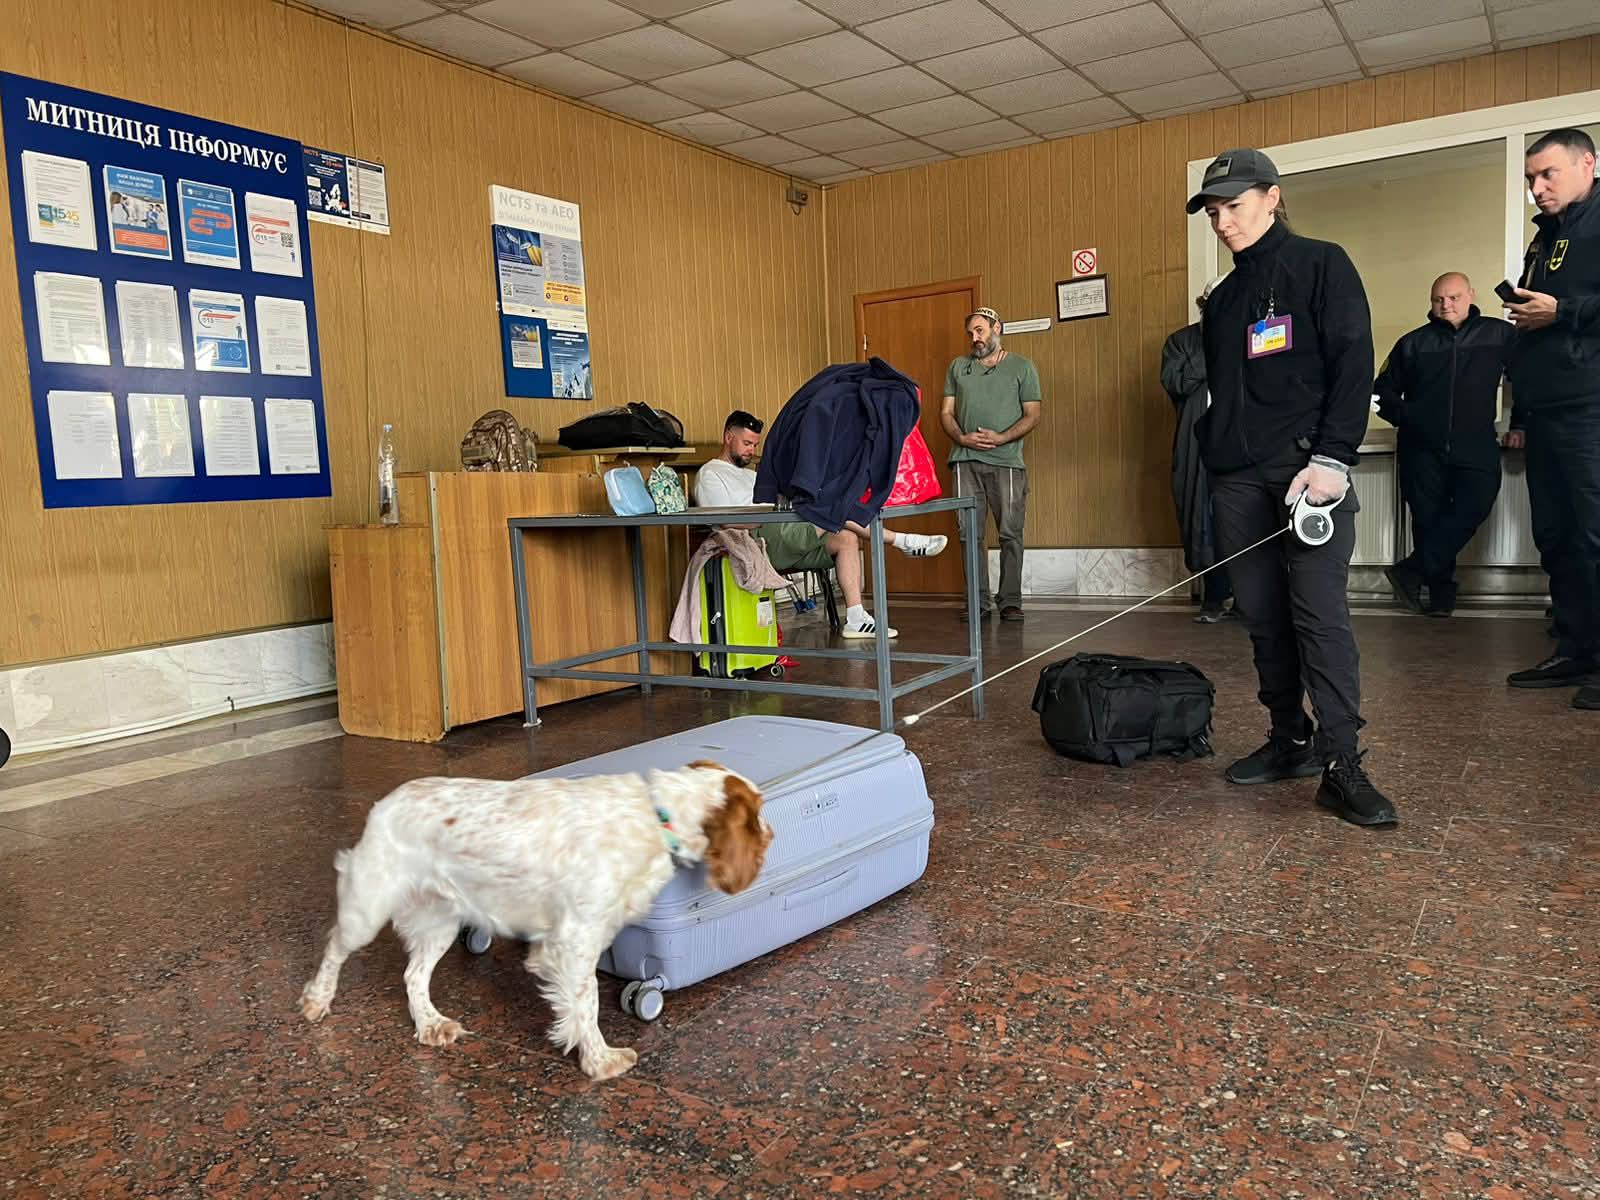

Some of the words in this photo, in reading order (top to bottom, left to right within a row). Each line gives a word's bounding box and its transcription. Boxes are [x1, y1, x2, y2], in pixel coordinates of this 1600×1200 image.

[25, 97, 162, 149] МИТНИЦЯ
[168, 128, 288, 174] ІНФОРМУЄ
[499, 191, 531, 210] NCTS
[53, 206, 80, 222] 1545
